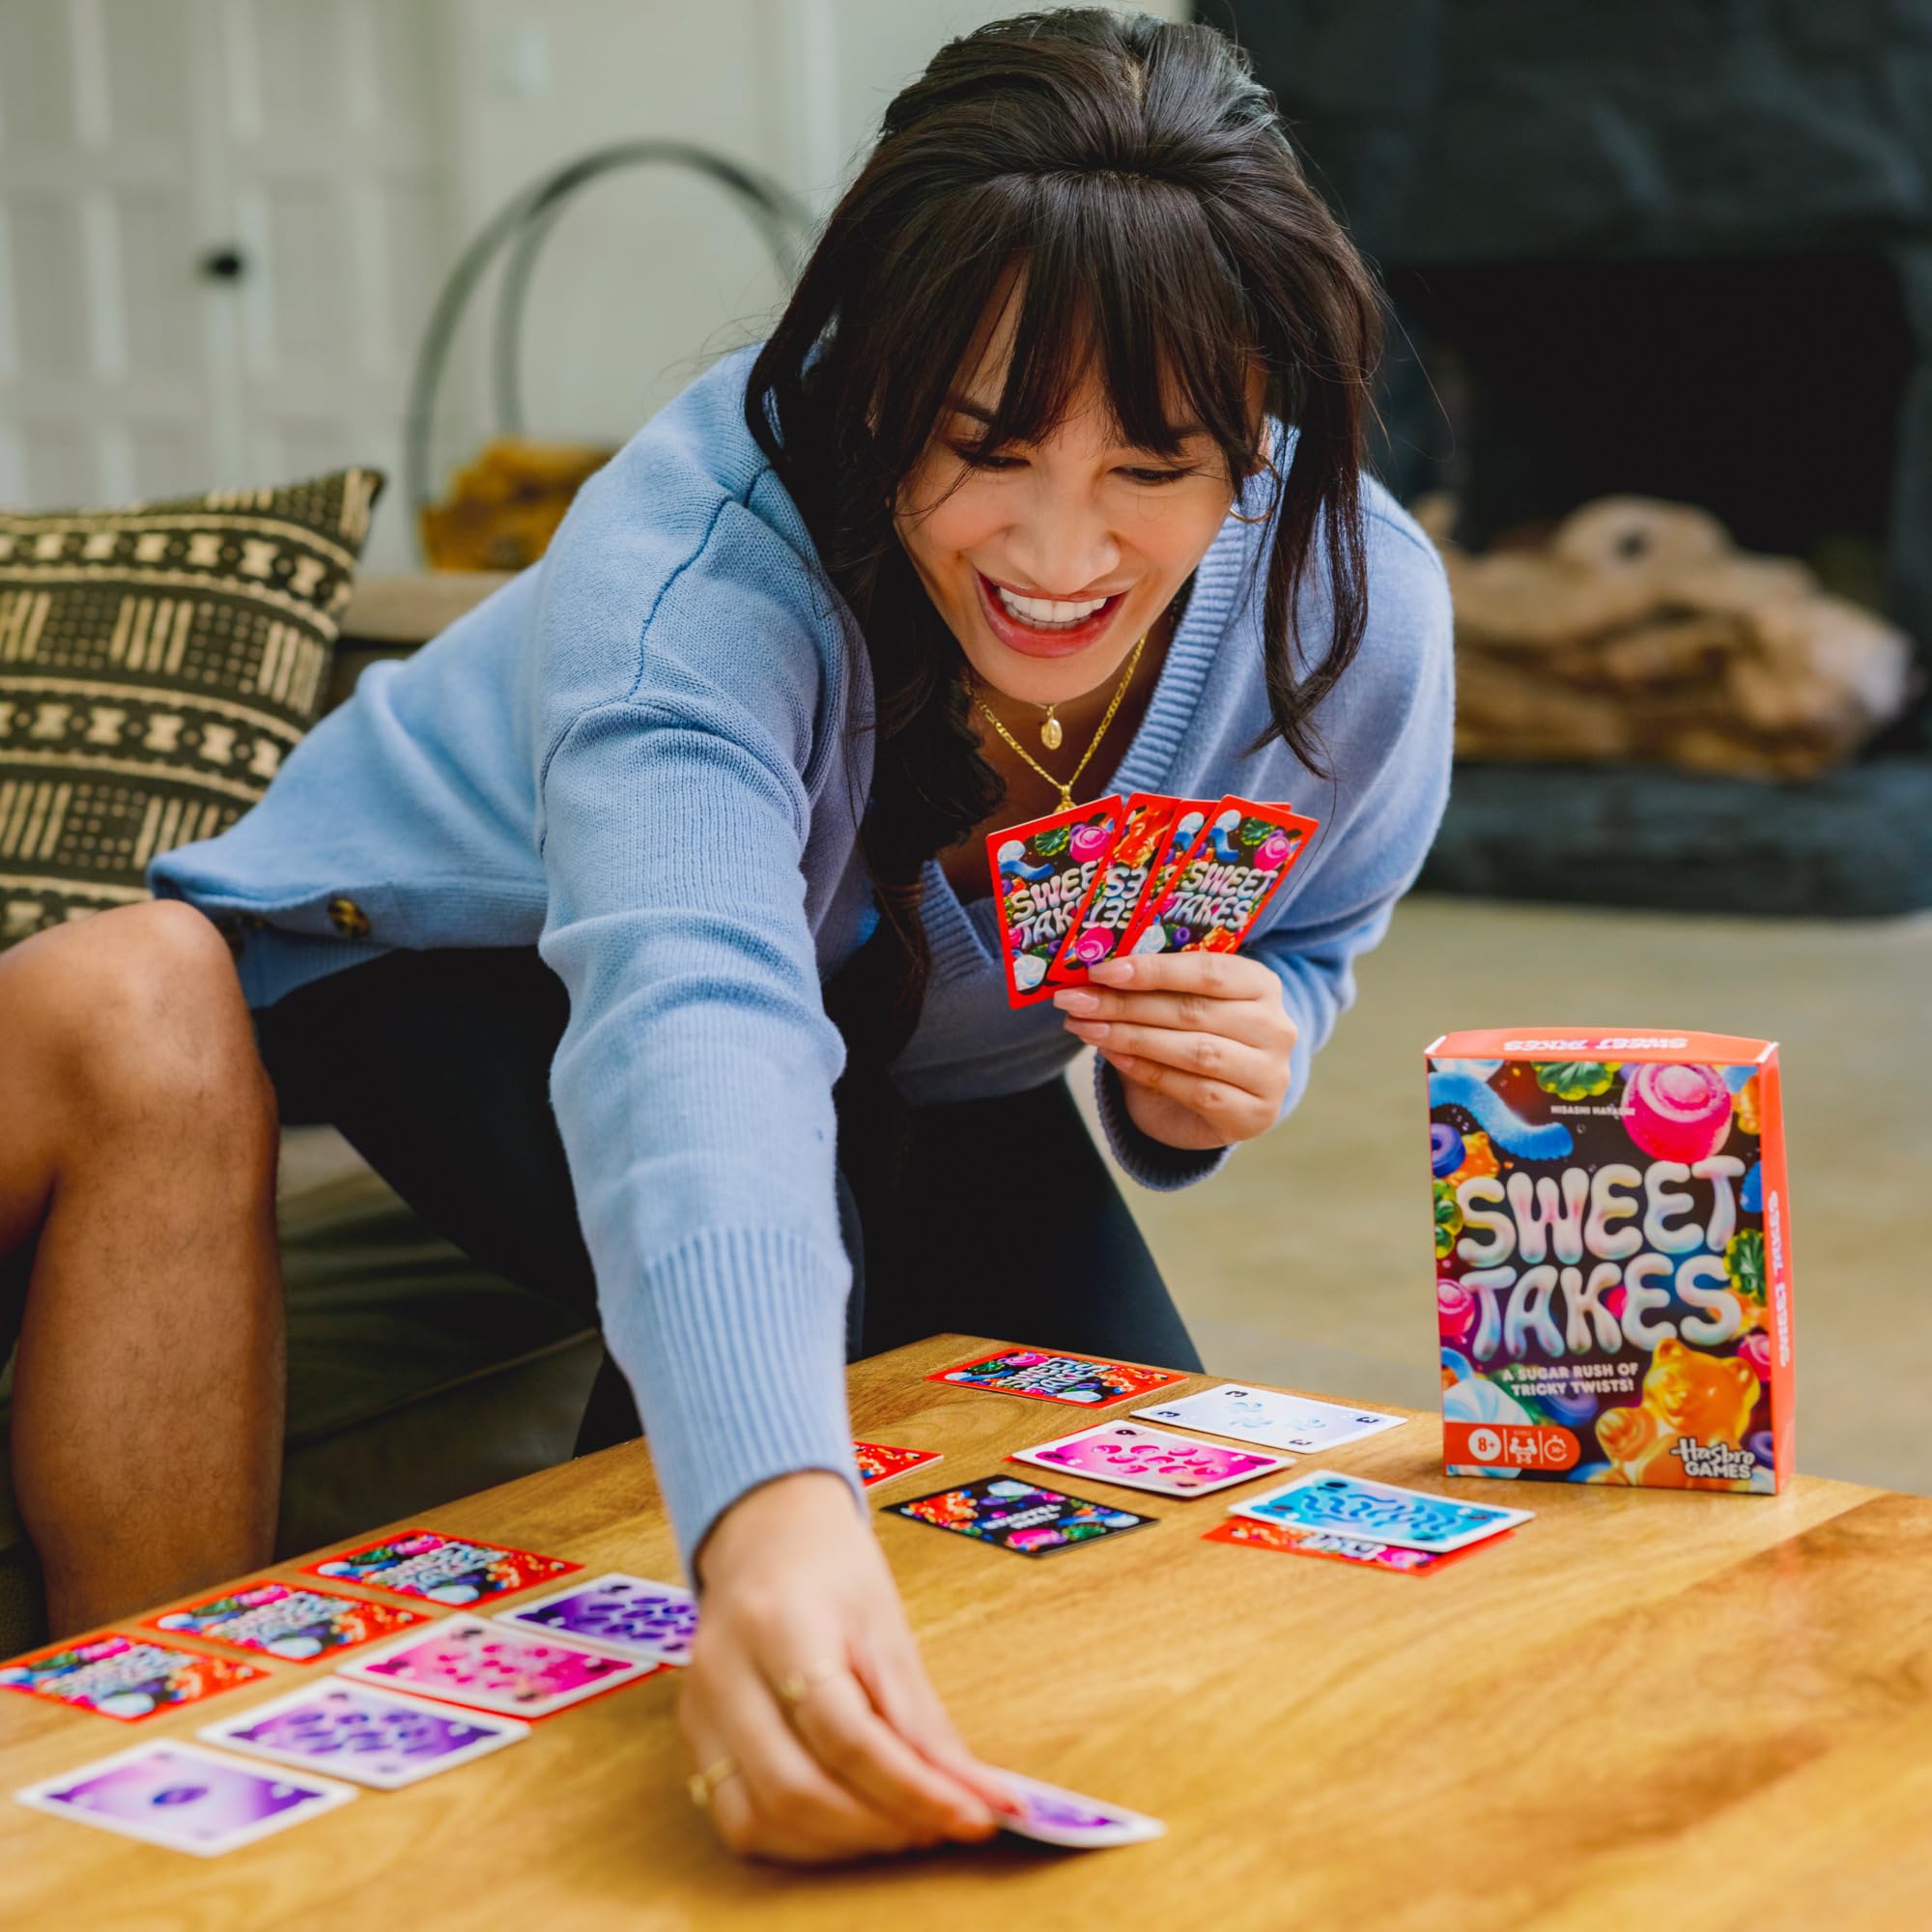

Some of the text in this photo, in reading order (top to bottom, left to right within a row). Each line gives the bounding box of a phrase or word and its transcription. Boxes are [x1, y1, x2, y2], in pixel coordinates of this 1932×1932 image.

[1011, 857, 1104, 921] SWEE
[1181, 861, 1279, 901] SWEET
[1015, 894, 1088, 950] TAK
[1163, 891, 1253, 929] TAKES
[1504, 1037, 1688, 1051] SWEET TAKES
[1457, 1155, 1745, 1266] SWEET
[1460, 1253, 1743, 1359] TAKES
[997, 1357, 1081, 1388] SWEET
[1025, 1362, 1111, 1393] TAKES
[1502, 1362, 1639, 1381] A SUGAR RUSH OF
[1511, 1378, 1635, 1397] TRICKY TWISTS!
[1477, 1436, 1496, 1453] 8+
[1670, 1436, 1755, 1465] Hasbro
[1684, 1462, 1751, 1479] GAMES
